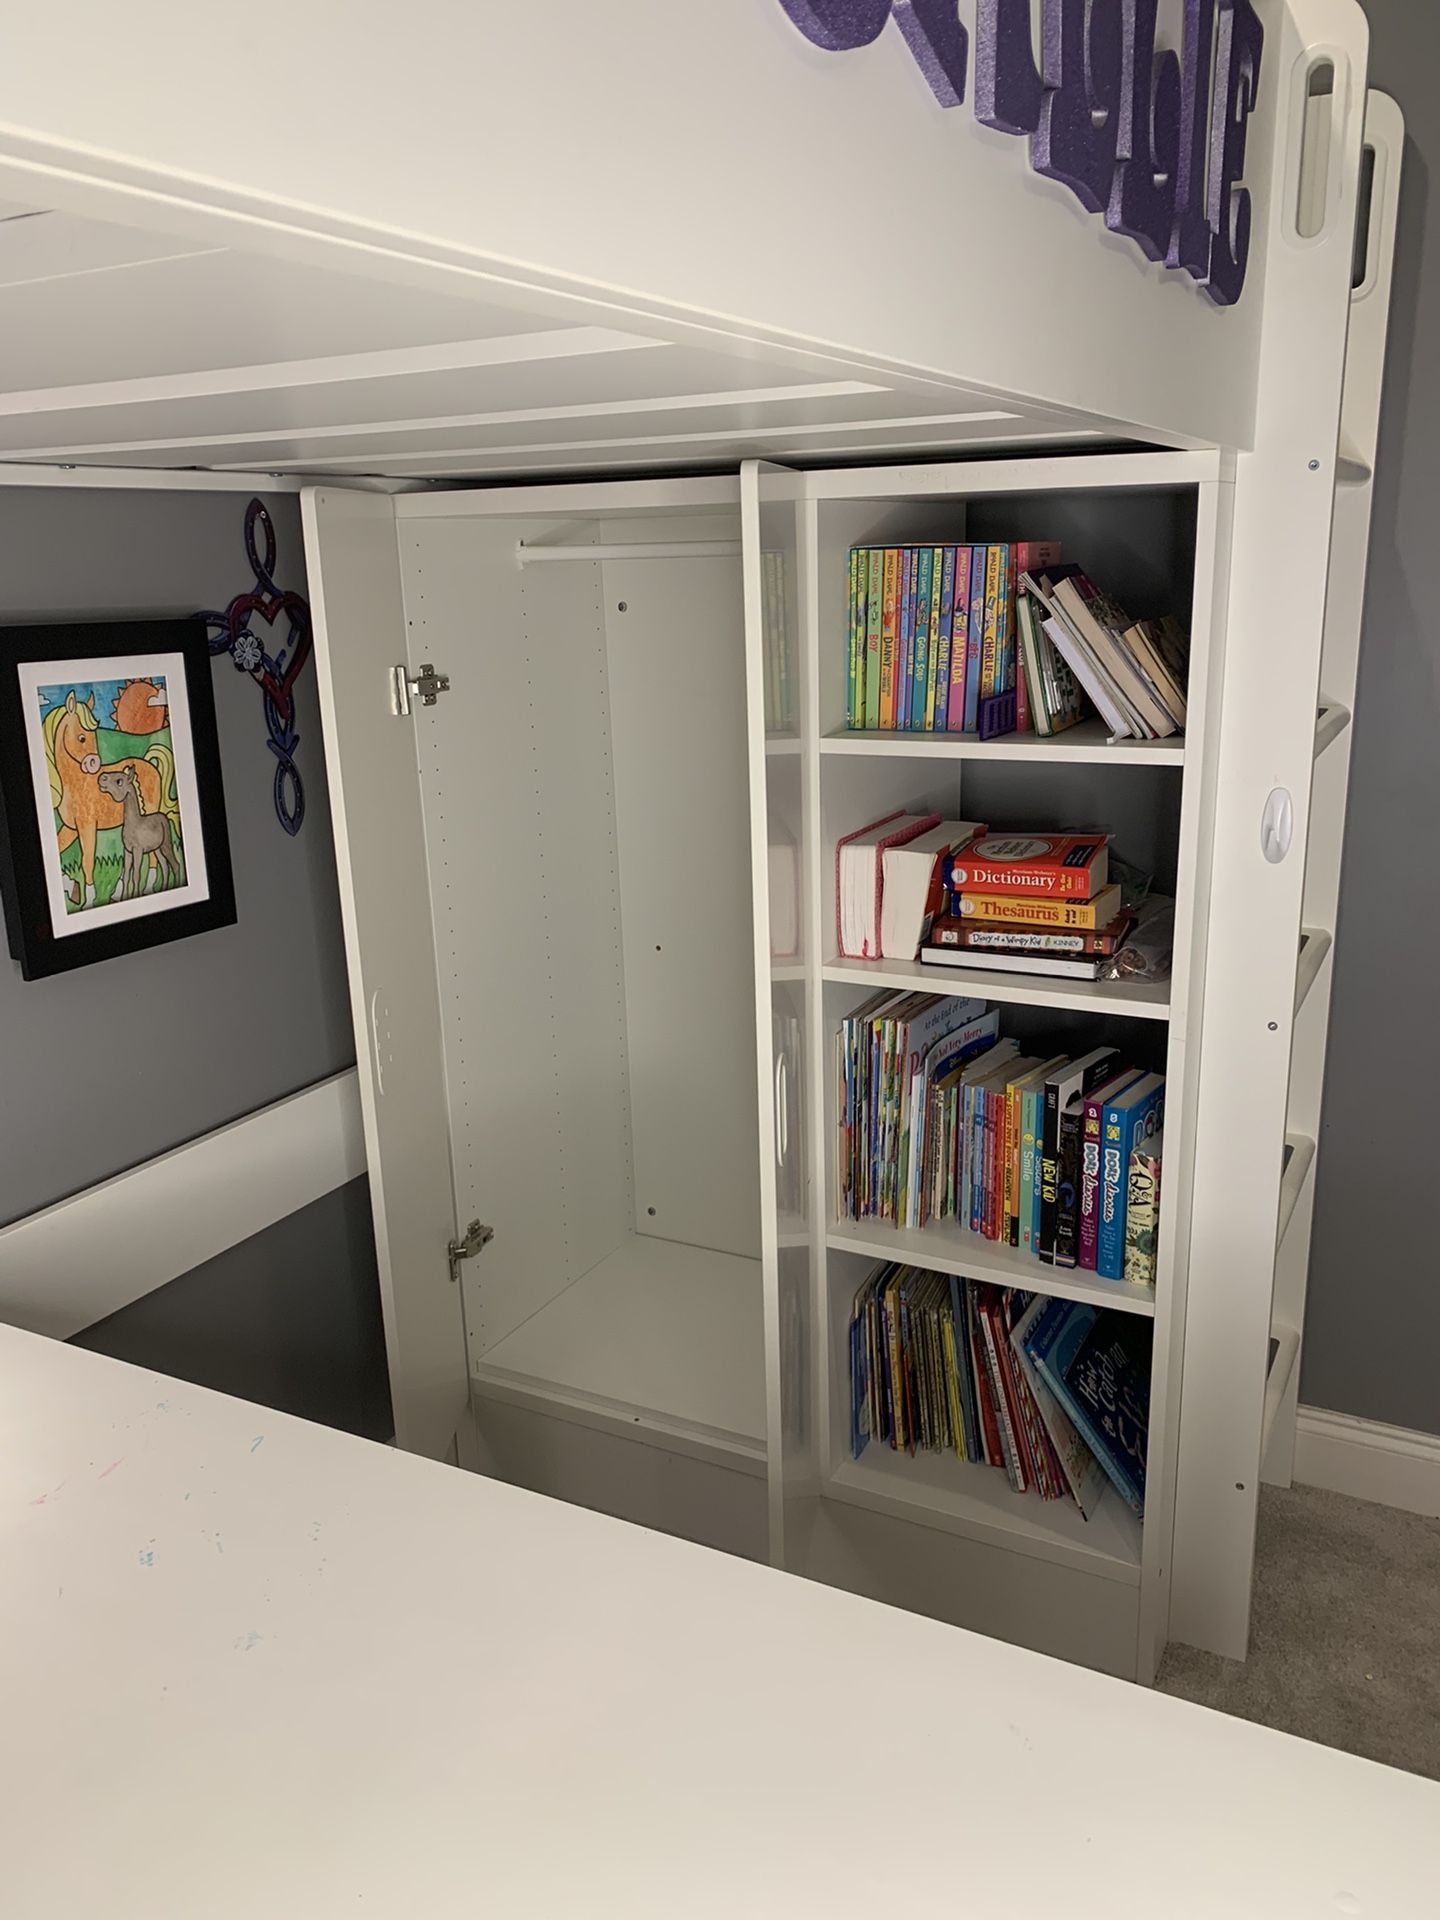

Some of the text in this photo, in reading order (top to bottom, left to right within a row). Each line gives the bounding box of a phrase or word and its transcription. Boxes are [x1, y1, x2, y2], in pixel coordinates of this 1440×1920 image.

[869, 634, 879, 652] BOY
[883, 636, 893, 668] DANNY
[916, 636, 926, 681] GOING SOLO
[938, 636, 949, 670] CHARLIE
[952, 636, 965, 684] MATILDA
[984, 636, 995, 672] CHARLIE
[972, 869, 1055, 889] Dictionary
[981, 901, 1059, 922] Thesaurus
[973, 934, 995, 944] Diary
[1006, 936, 1029, 946] Wimpy
[1030, 936, 1042, 946] Kid
[963, 1027, 983, 1043] Merry
[1048, 1093, 1056, 1109] CRAFT
[1088, 1107, 1098, 1118] 2
[1022, 1150, 1033, 1181] Smile
[1034, 1156, 1042, 1196] Sisters
[1083, 1142, 1099, 1177] DORK
[1104, 1148, 1120, 1183] DORK
[1042, 1158, 1056, 1203] NEW KID
[1081, 1174, 1099, 1216] diaries
[1128, 1171, 1154, 1207] Q&A
[1102, 1181, 1120, 1223] diaries
[1078, 1360, 1101, 1410] How
[1095, 1350, 1119, 1413] Catch
